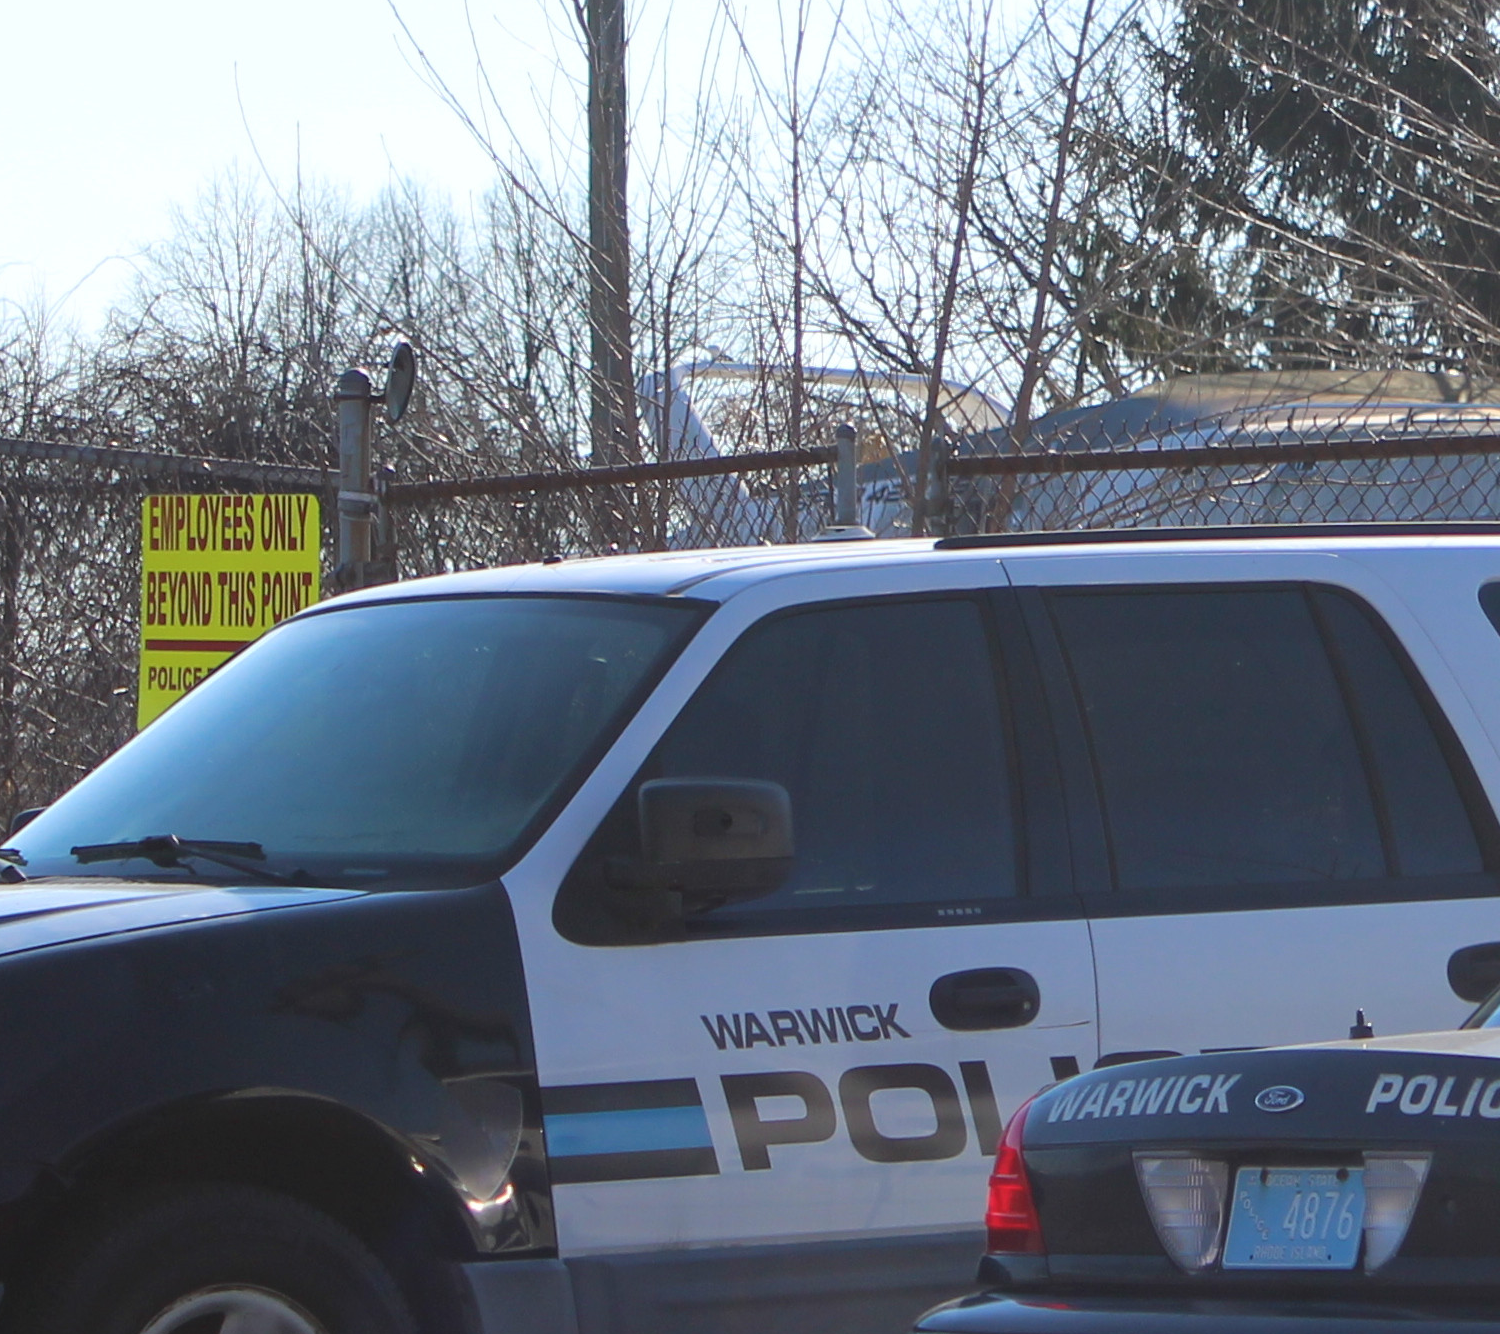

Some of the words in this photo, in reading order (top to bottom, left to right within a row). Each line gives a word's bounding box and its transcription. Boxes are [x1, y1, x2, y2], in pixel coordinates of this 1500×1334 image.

[150, 495, 255, 552] EMPLOYEES
[261, 495, 309, 552] ONLY
[146, 571, 213, 627] BEYOND
[218, 571, 256, 628] THIS
[261, 571, 312, 627] POINT
[700, 1002, 912, 1051] WARWICK
[1046, 1073, 1243, 1124] WARWICK
[1239, 1190, 1269, 1241] POLICE
[1283, 1190, 1356, 1241] 4876
[1253, 1245, 1288, 1261] RHODE
[1290, 1245, 1328, 1261] ISLAND
